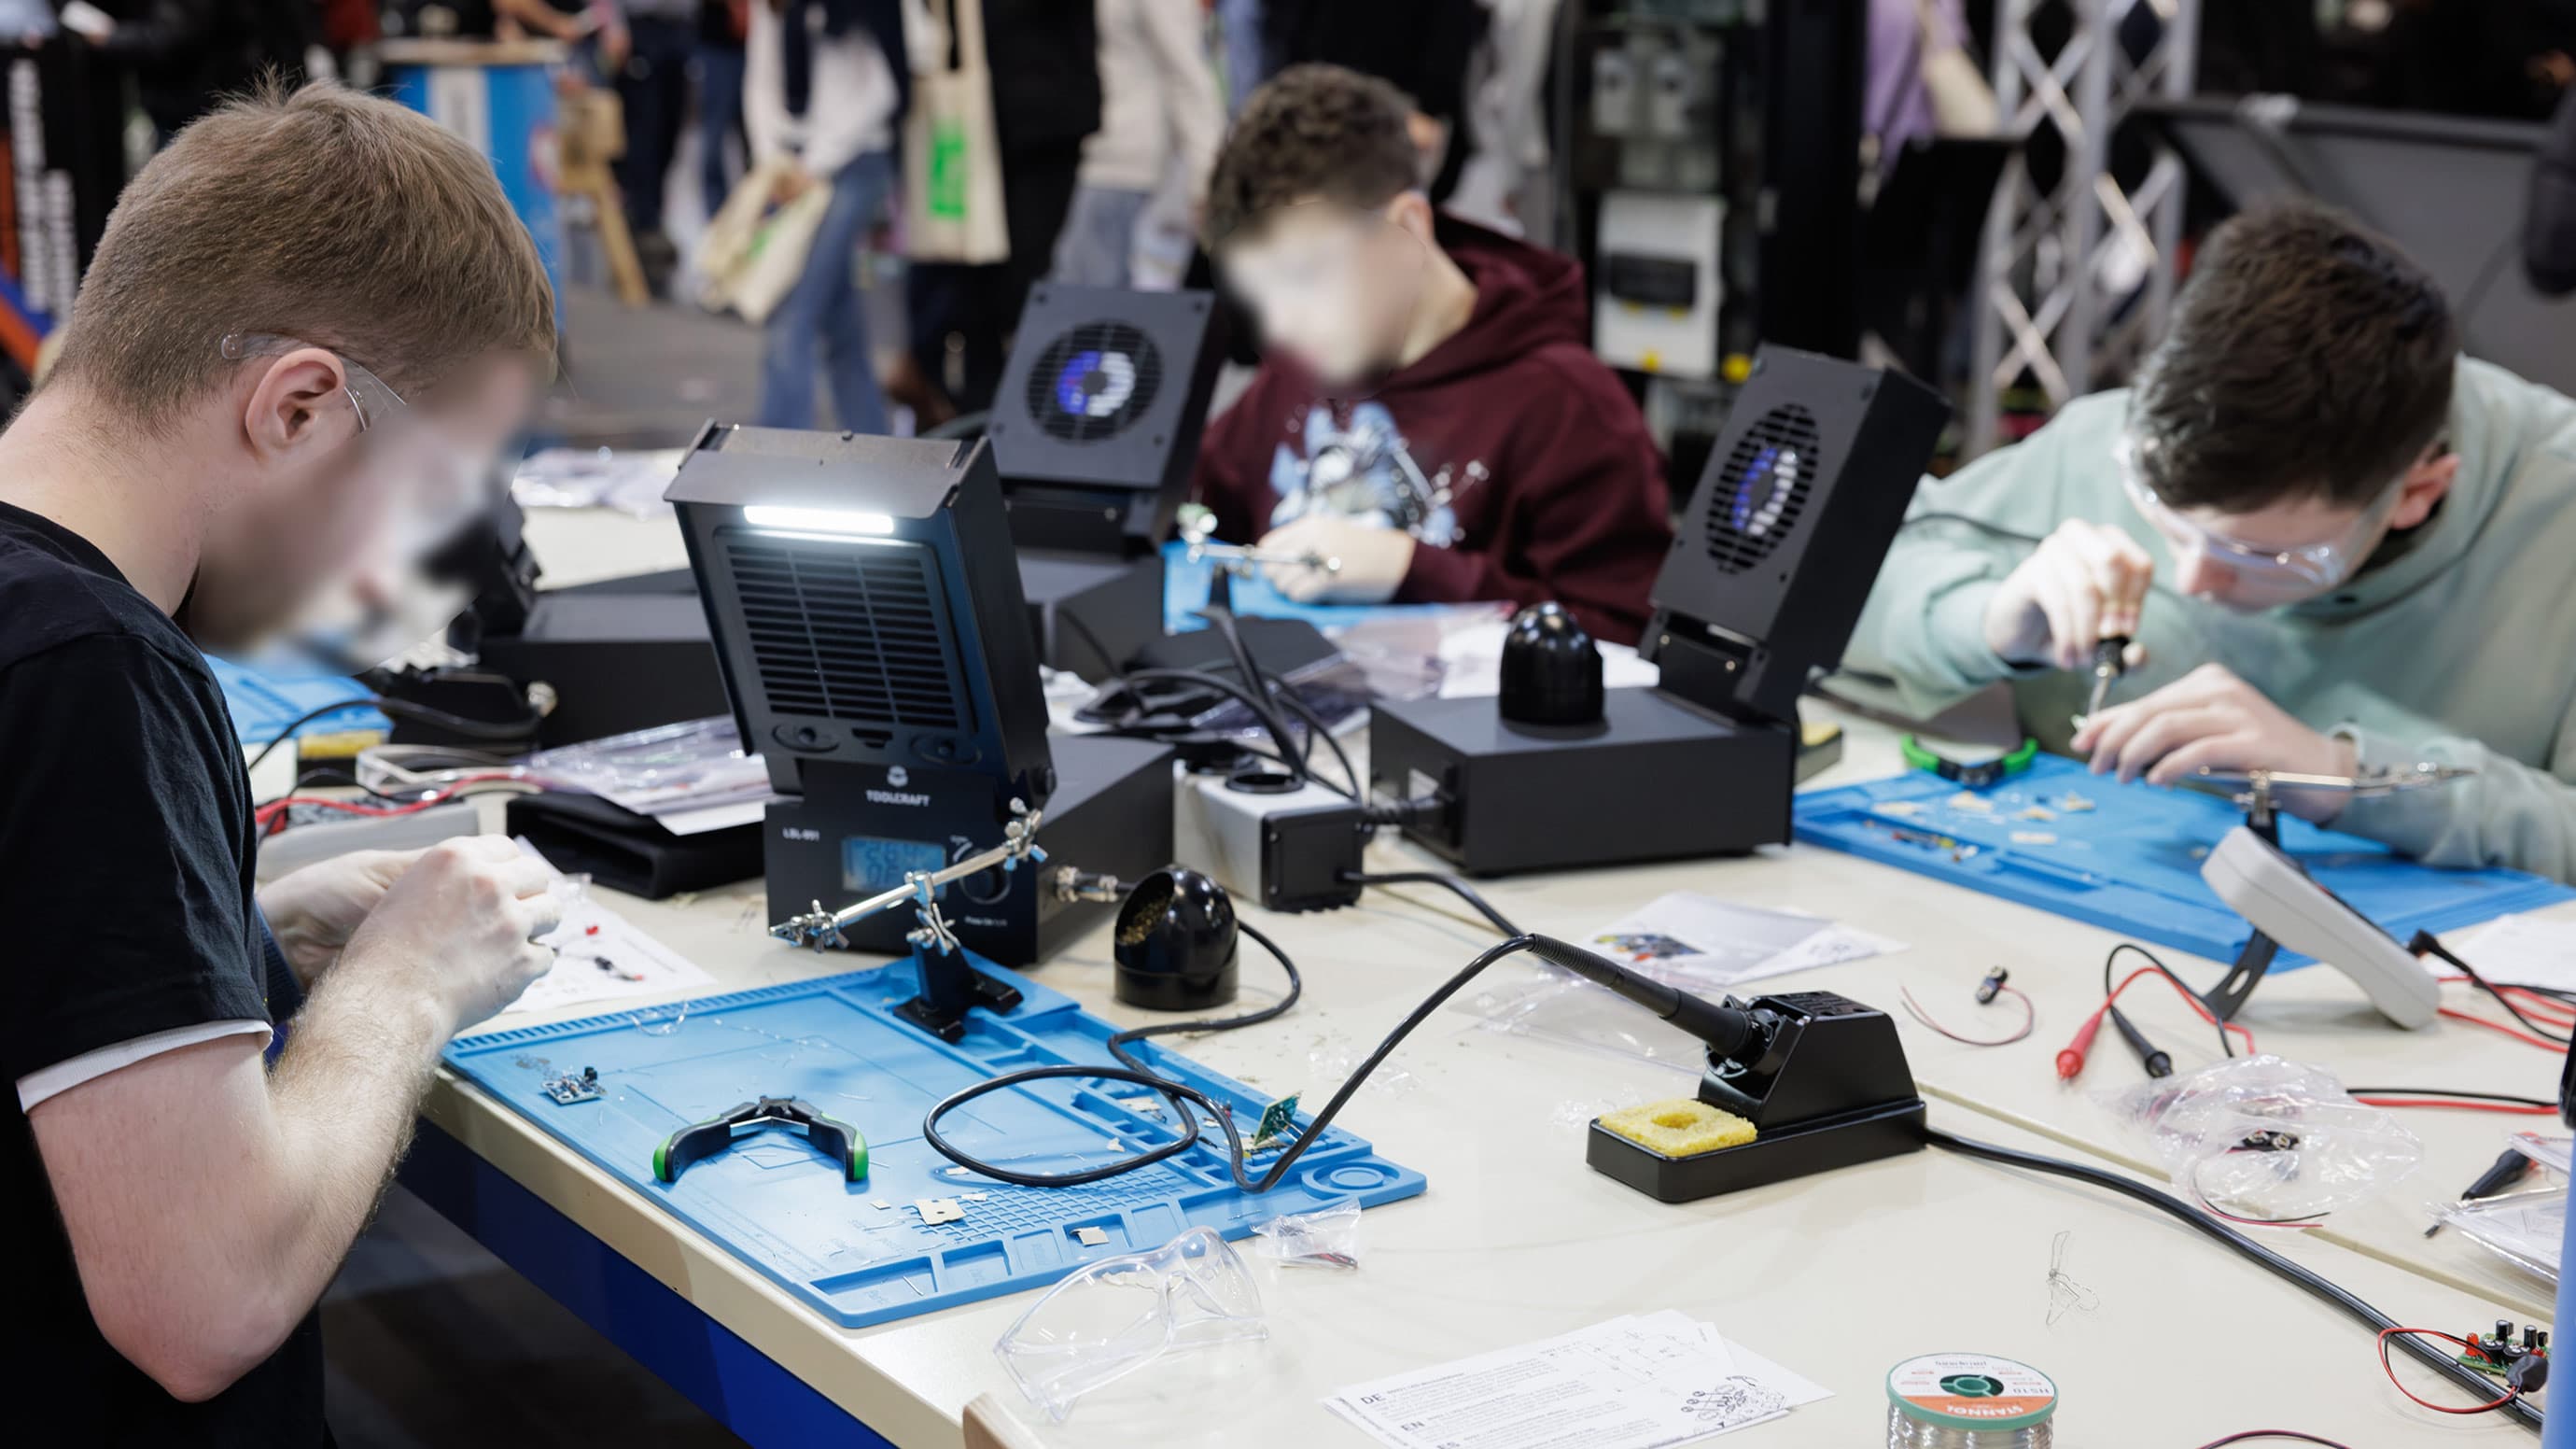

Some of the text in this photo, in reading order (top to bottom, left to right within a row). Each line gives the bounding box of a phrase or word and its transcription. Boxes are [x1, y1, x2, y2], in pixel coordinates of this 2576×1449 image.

[865, 790, 930, 807] TOOLCRAFT
[1361, 1393, 1386, 1405] DE
[1947, 1405, 2024, 1417] STANNOL
